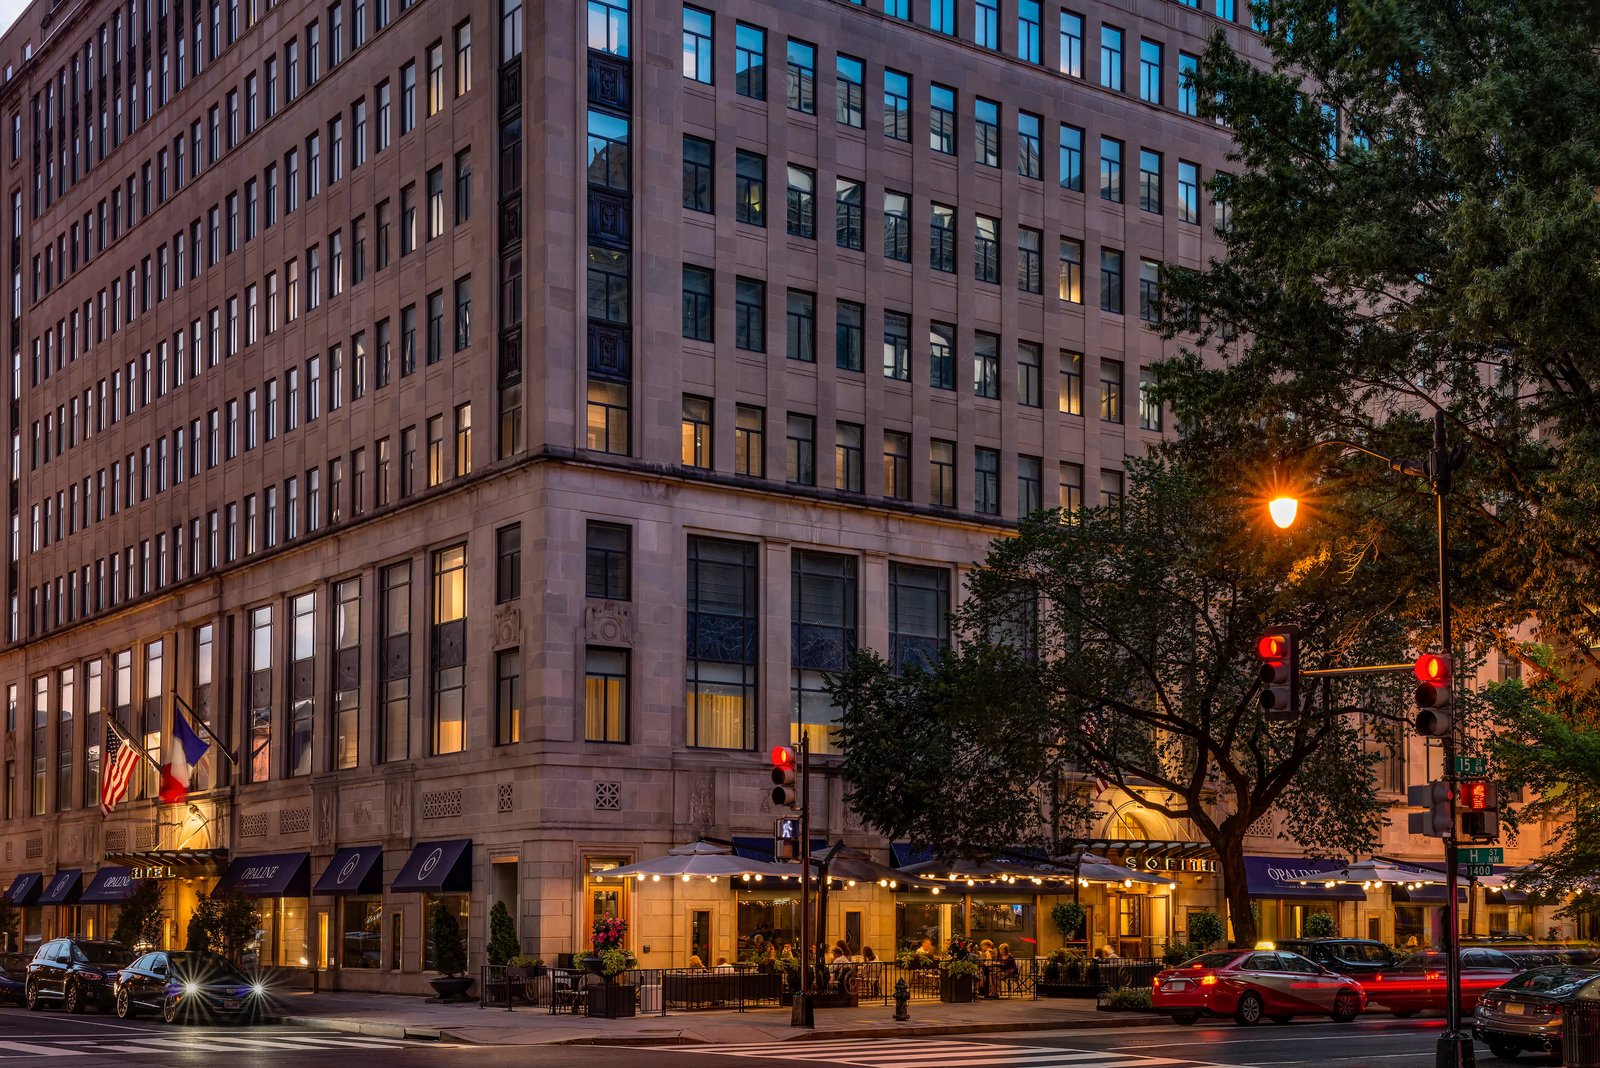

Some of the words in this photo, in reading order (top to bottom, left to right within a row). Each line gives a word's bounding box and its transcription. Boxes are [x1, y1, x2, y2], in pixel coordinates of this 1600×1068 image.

[1460, 758, 1470, 771] 15
[1470, 849, 1478, 862] H
[1489, 848, 1498, 856] ST
[241, 866, 279, 880] OPALINE
[1470, 866, 1490, 876] 1400
